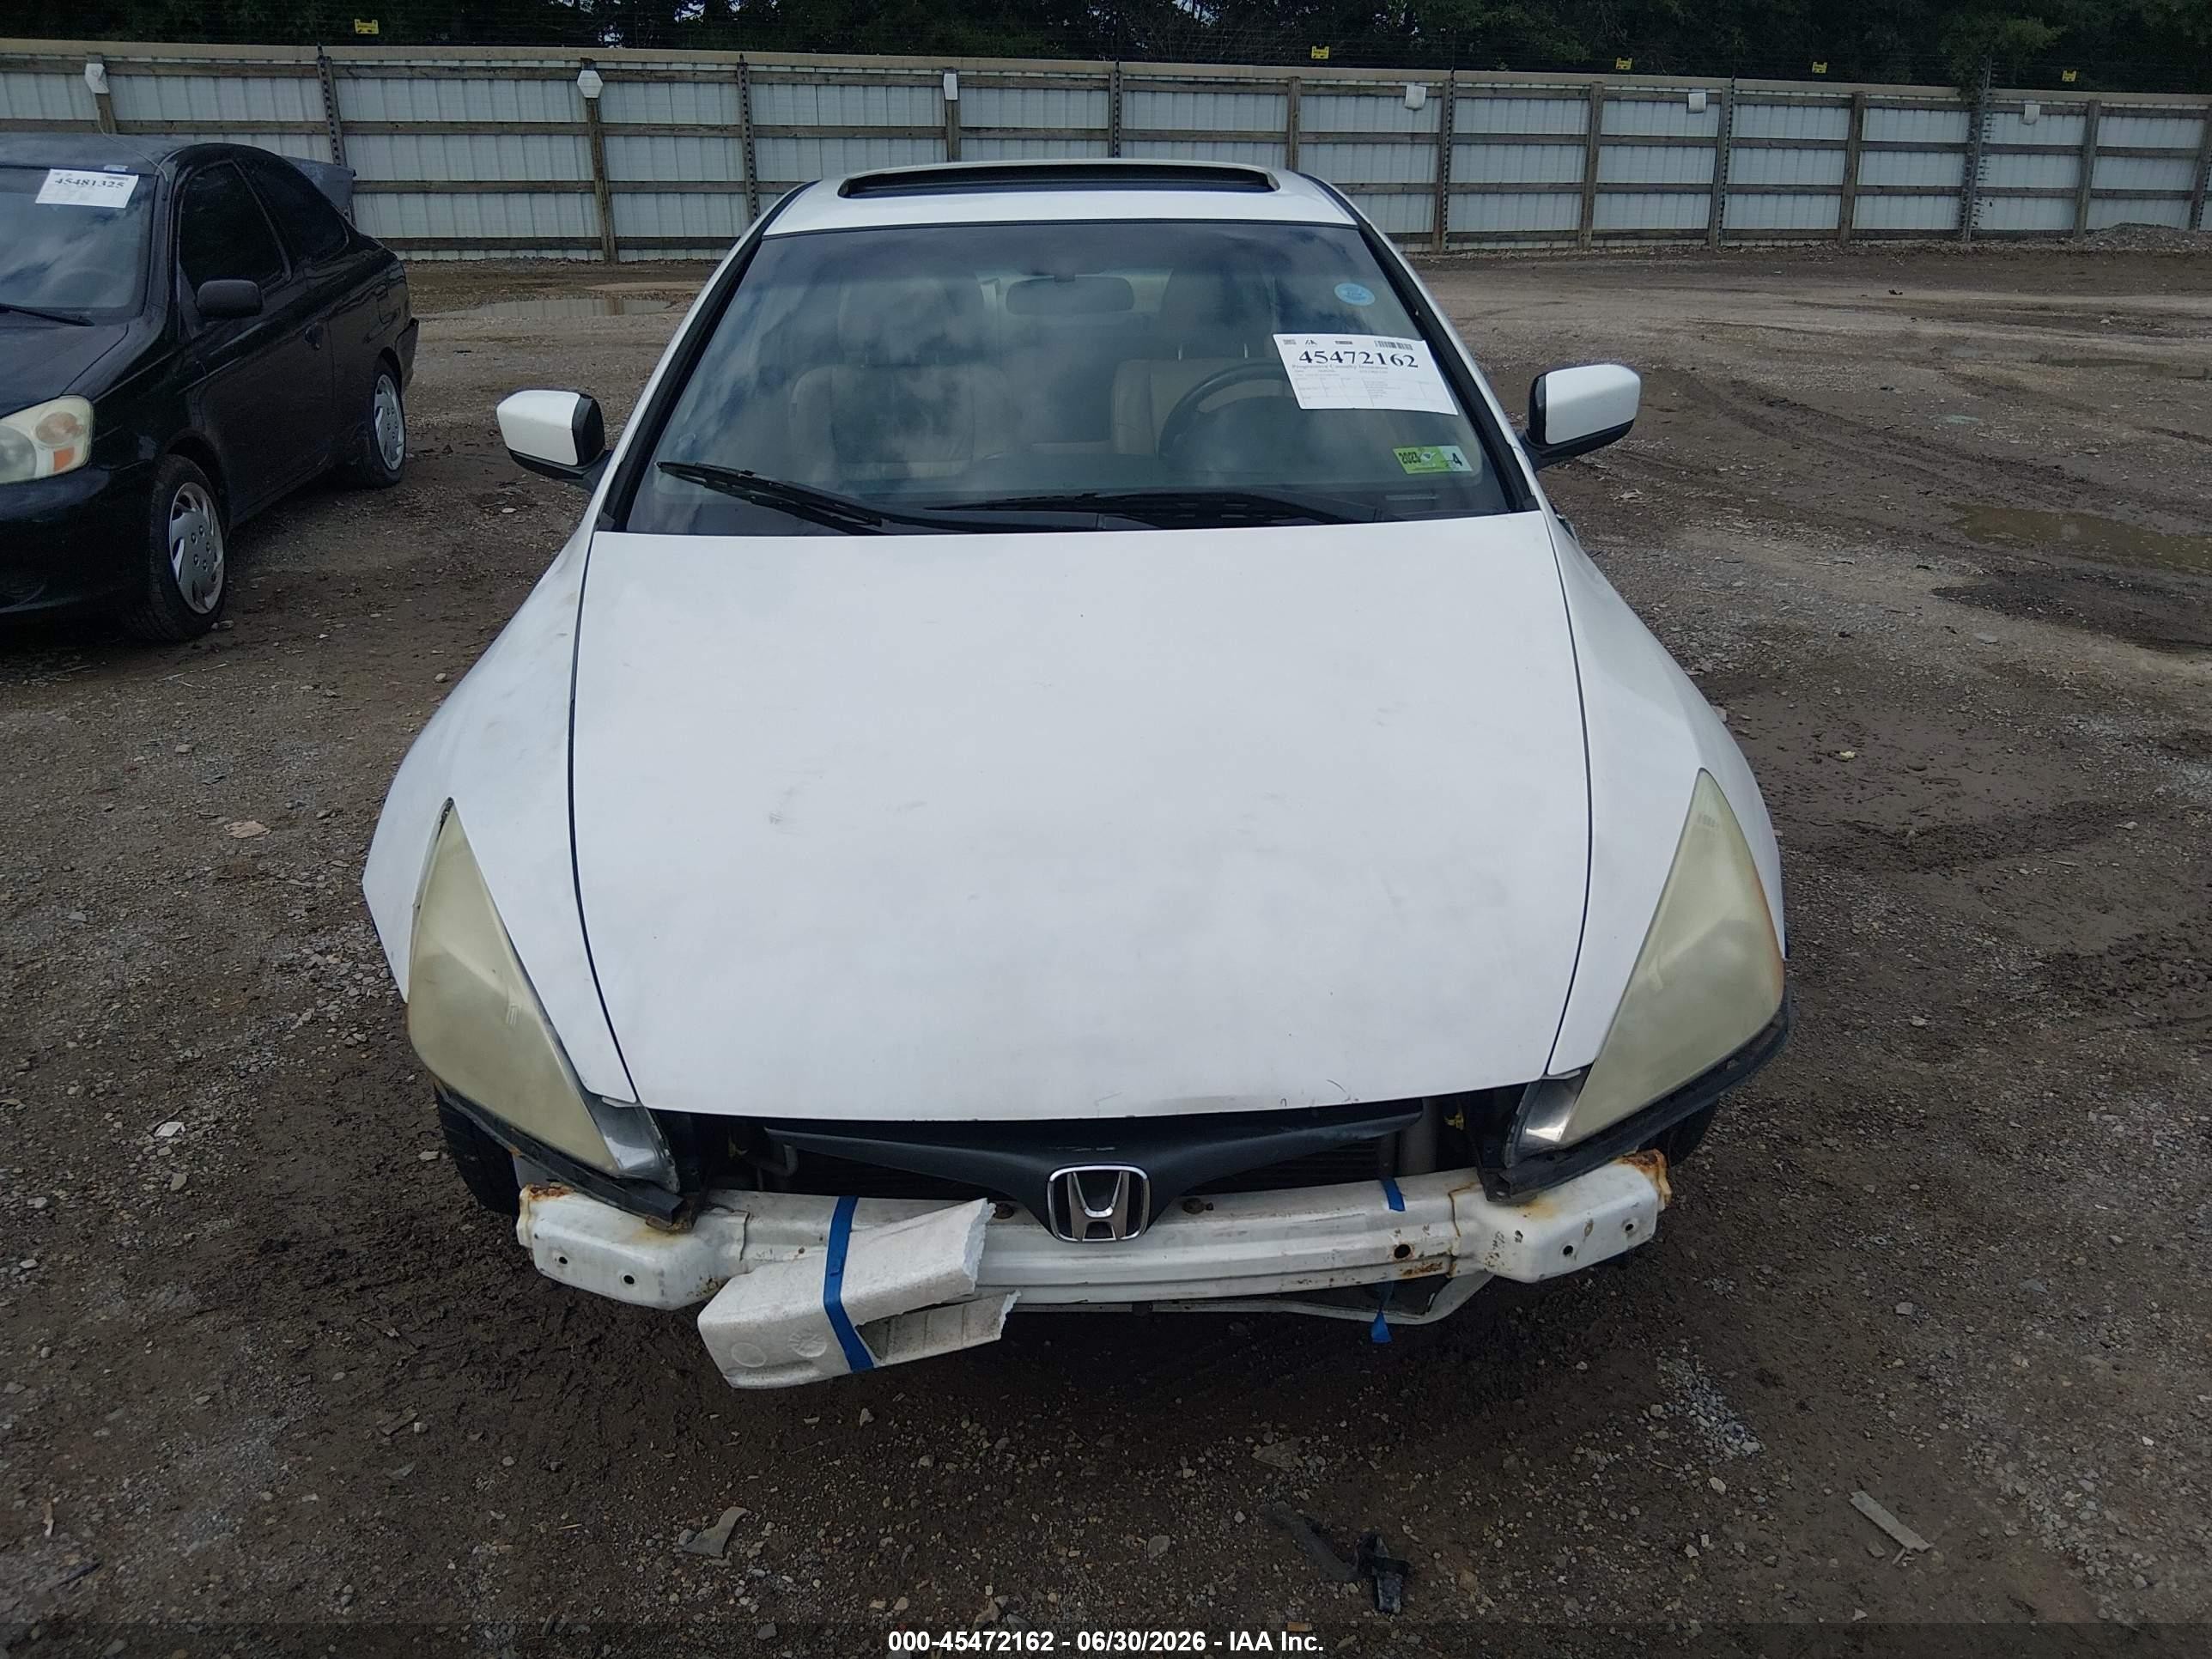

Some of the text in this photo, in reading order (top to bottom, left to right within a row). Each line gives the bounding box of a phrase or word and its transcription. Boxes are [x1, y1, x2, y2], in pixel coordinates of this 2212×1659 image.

[55, 178, 125, 188] 45481325
[1299, 350, 1419, 368] 45472162
[1398, 452, 1463, 466] 2023 4
